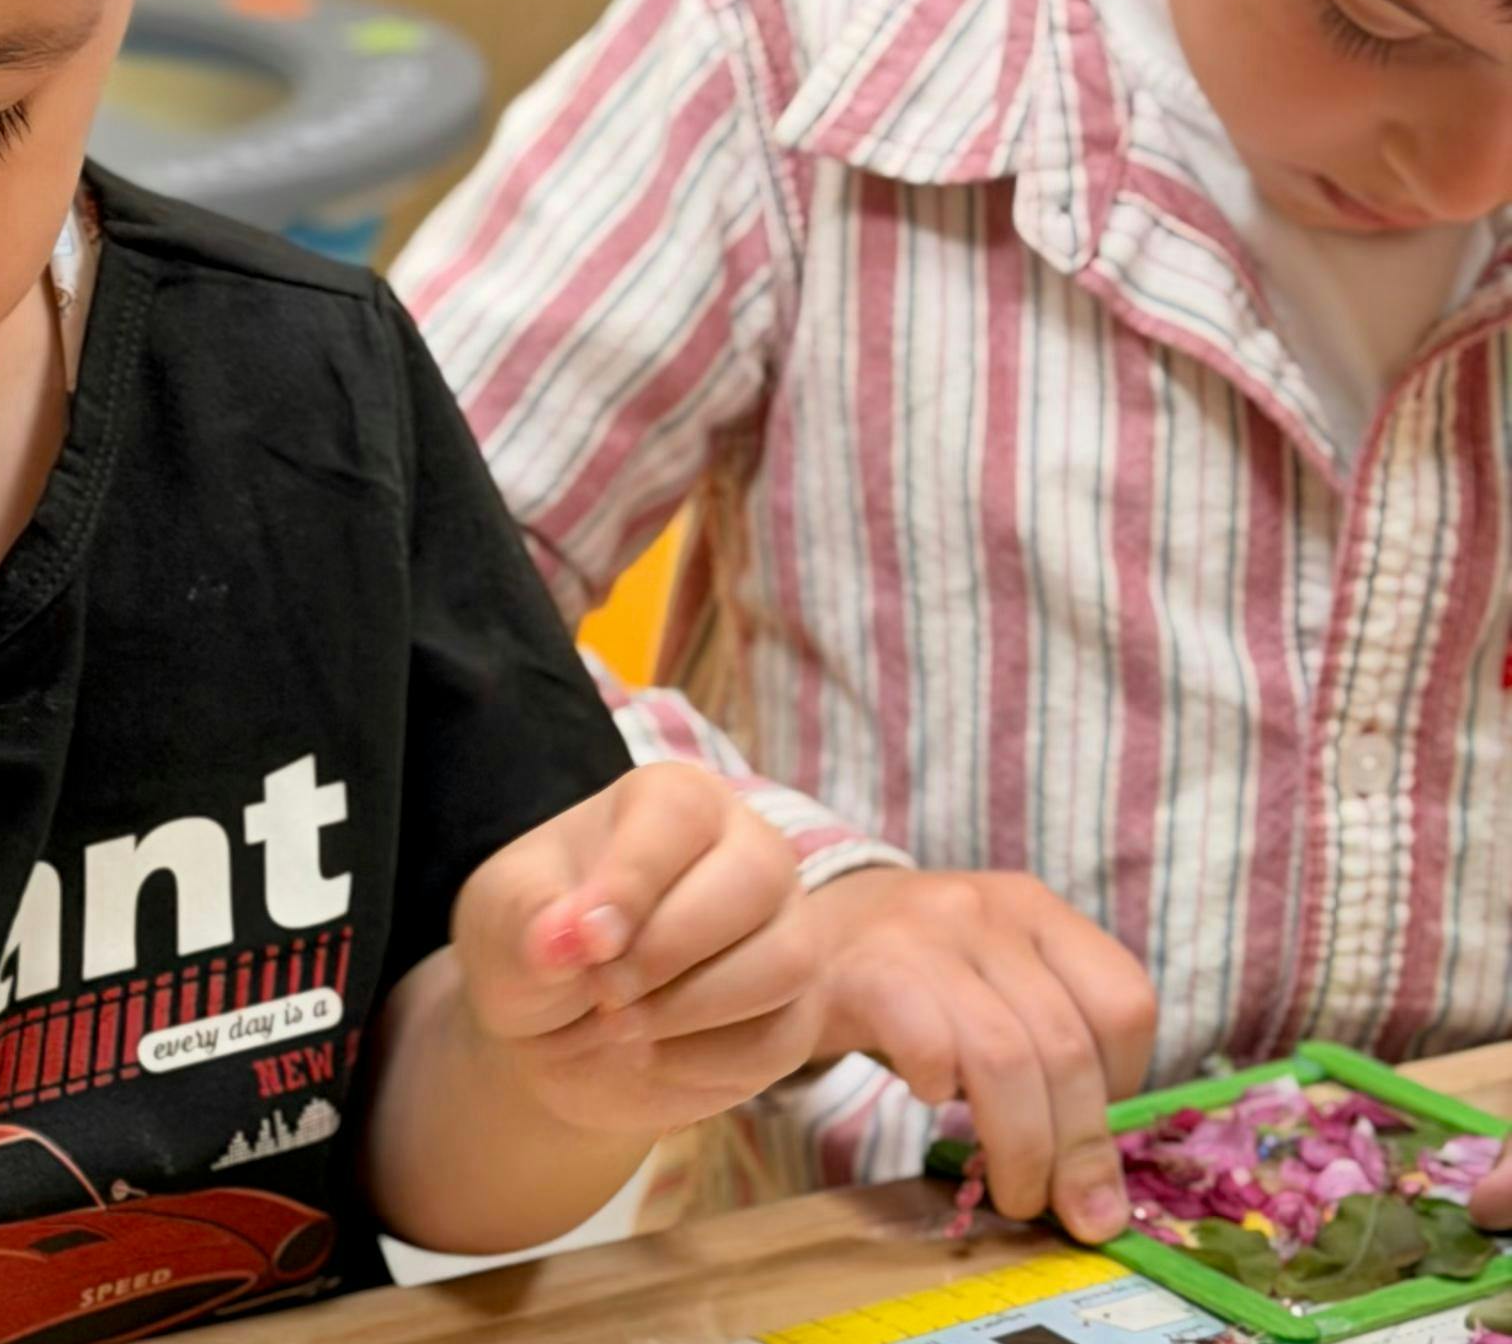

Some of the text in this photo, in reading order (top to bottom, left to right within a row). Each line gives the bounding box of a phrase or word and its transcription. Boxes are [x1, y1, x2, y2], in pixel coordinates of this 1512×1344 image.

[152, 998, 330, 1061] every day is a
[251, 1041, 336, 1099] NEW
[79, 1267, 172, 1309] SPEED
